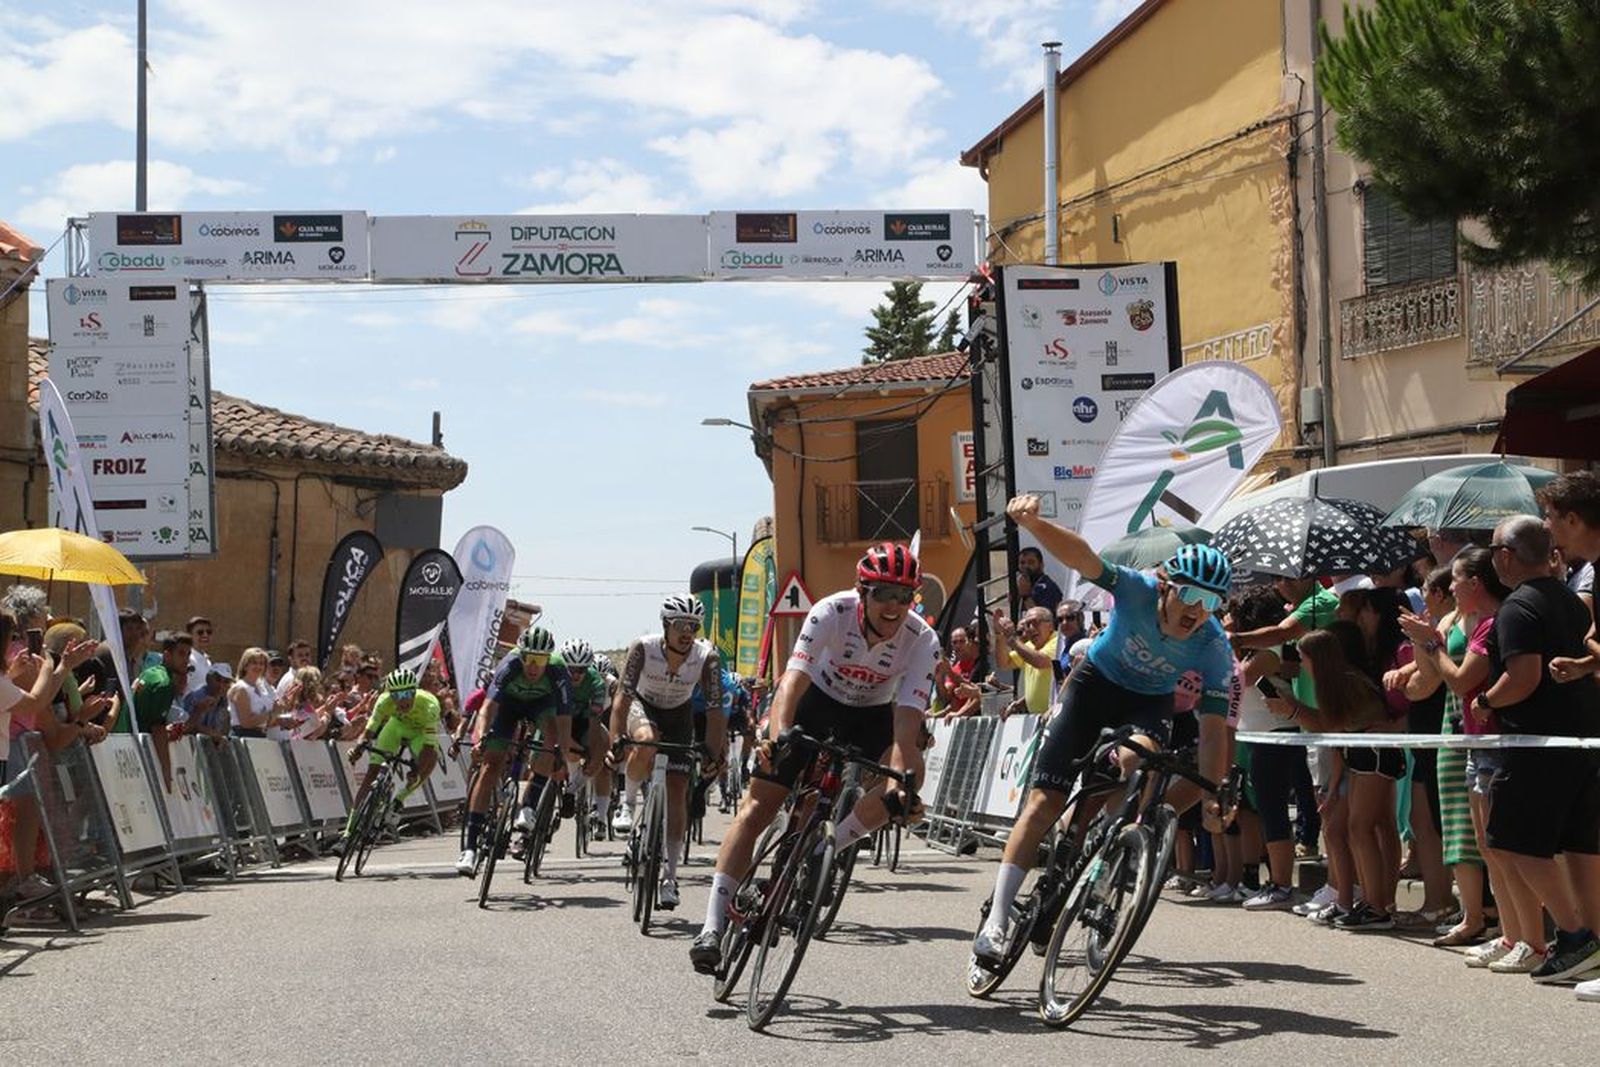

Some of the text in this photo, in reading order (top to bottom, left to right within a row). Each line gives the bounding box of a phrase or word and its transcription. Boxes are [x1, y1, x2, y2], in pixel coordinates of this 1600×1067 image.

[210, 224, 260, 237] cobreros
[824, 223, 871, 235] cobreros
[241, 251, 295, 265] ARIMA
[853, 249, 905, 262] ARIMA
[502, 253, 624, 275] ZAMORA
[1119, 276, 1148, 286] VISTA
[92, 458, 147, 475] FROIZ
[1053, 465, 1096, 480] BigMat
